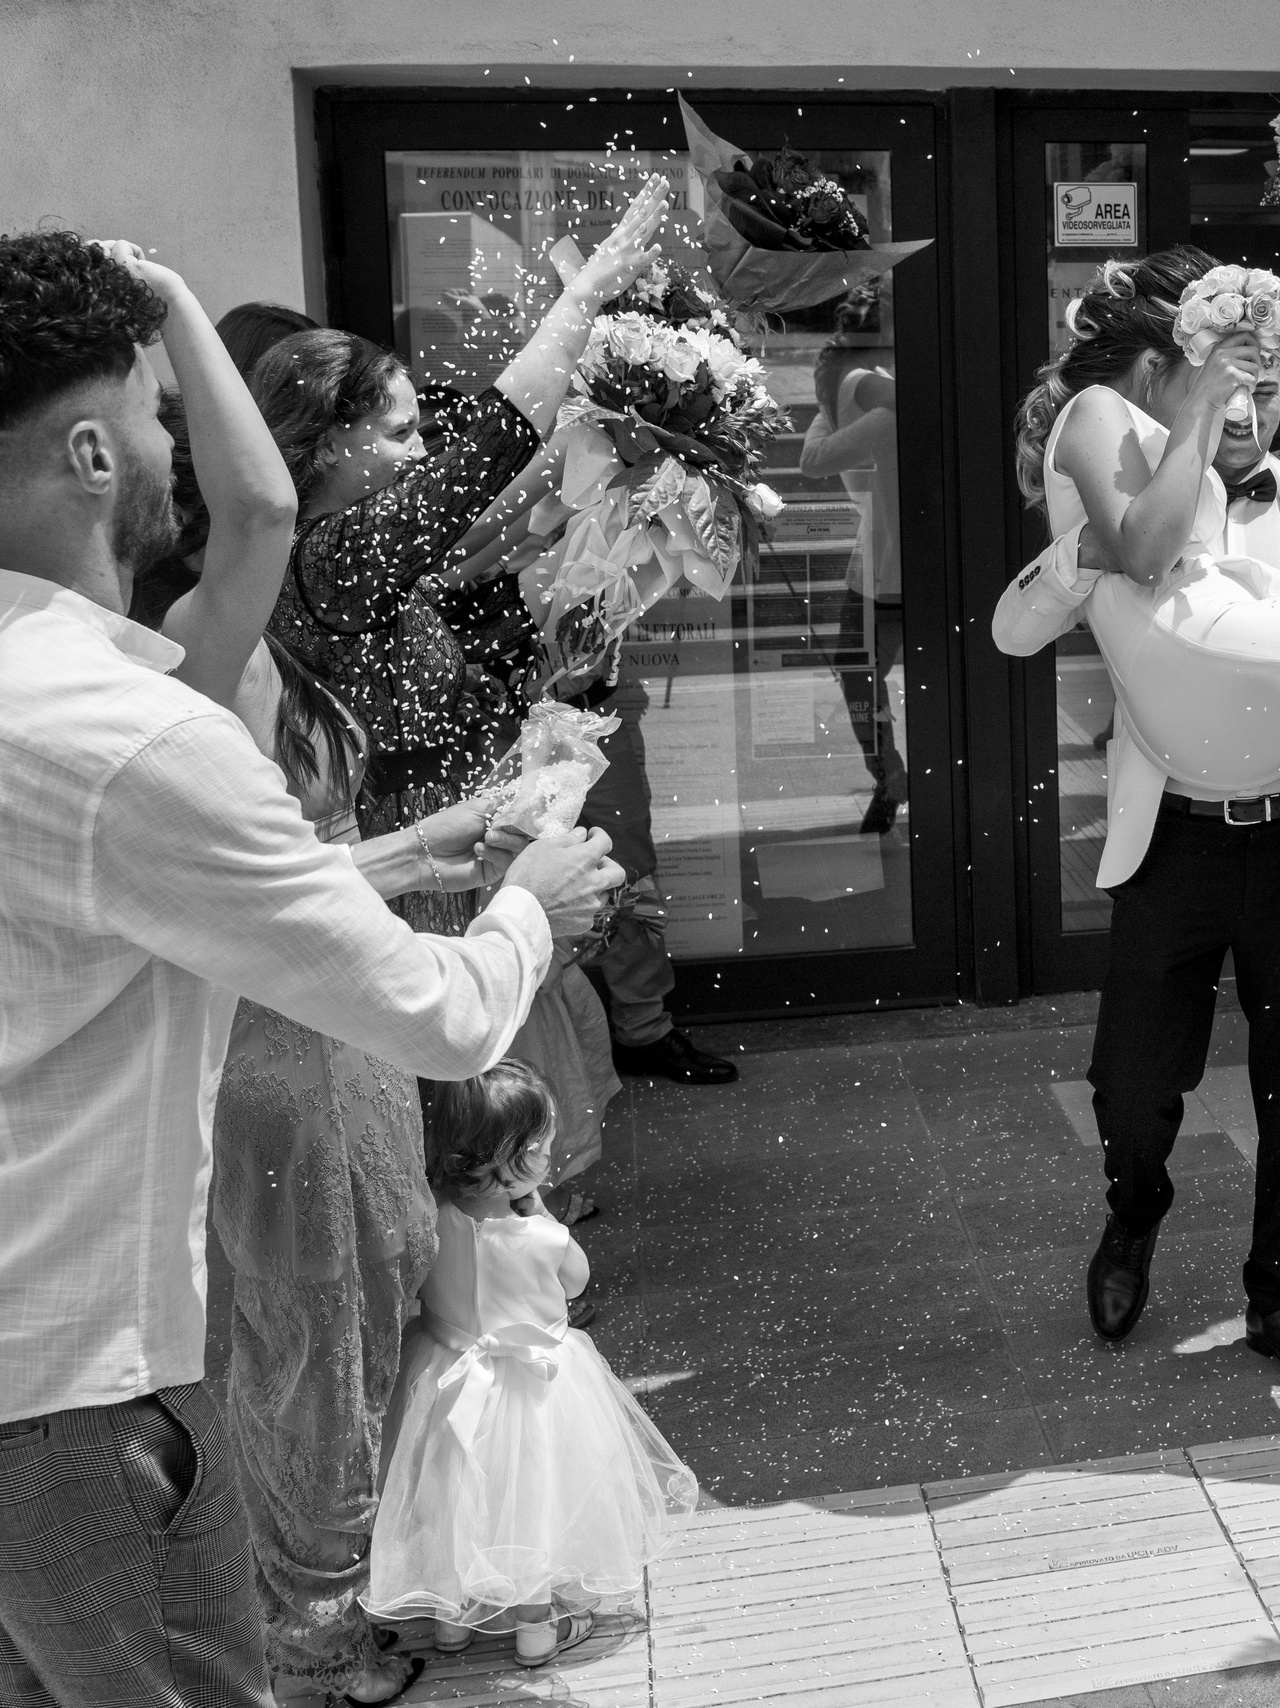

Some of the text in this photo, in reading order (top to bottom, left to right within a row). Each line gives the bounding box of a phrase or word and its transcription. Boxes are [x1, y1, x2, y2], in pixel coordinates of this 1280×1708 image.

[416, 167, 486, 179] REFERENDUM
[492, 167, 543, 179] POPOLARI
[550, 167, 561, 179] DI
[567, 167, 626, 179] DOMENIC
[441, 190, 575, 211] CONVOCAZIONE
[587, 190, 615, 211] DEI
[1095, 203, 1131, 219] AREA
[1062, 220, 1131, 230] VIDEOSORVEGLIATA
[636, 622, 716, 642] ELETTORALI
[629, 653, 680, 667] NUOVA
[849, 701, 870, 711] HELP
[835, 712, 870, 722] UKRAINE
[1069, 1556, 1114, 1567] APPROVATO
